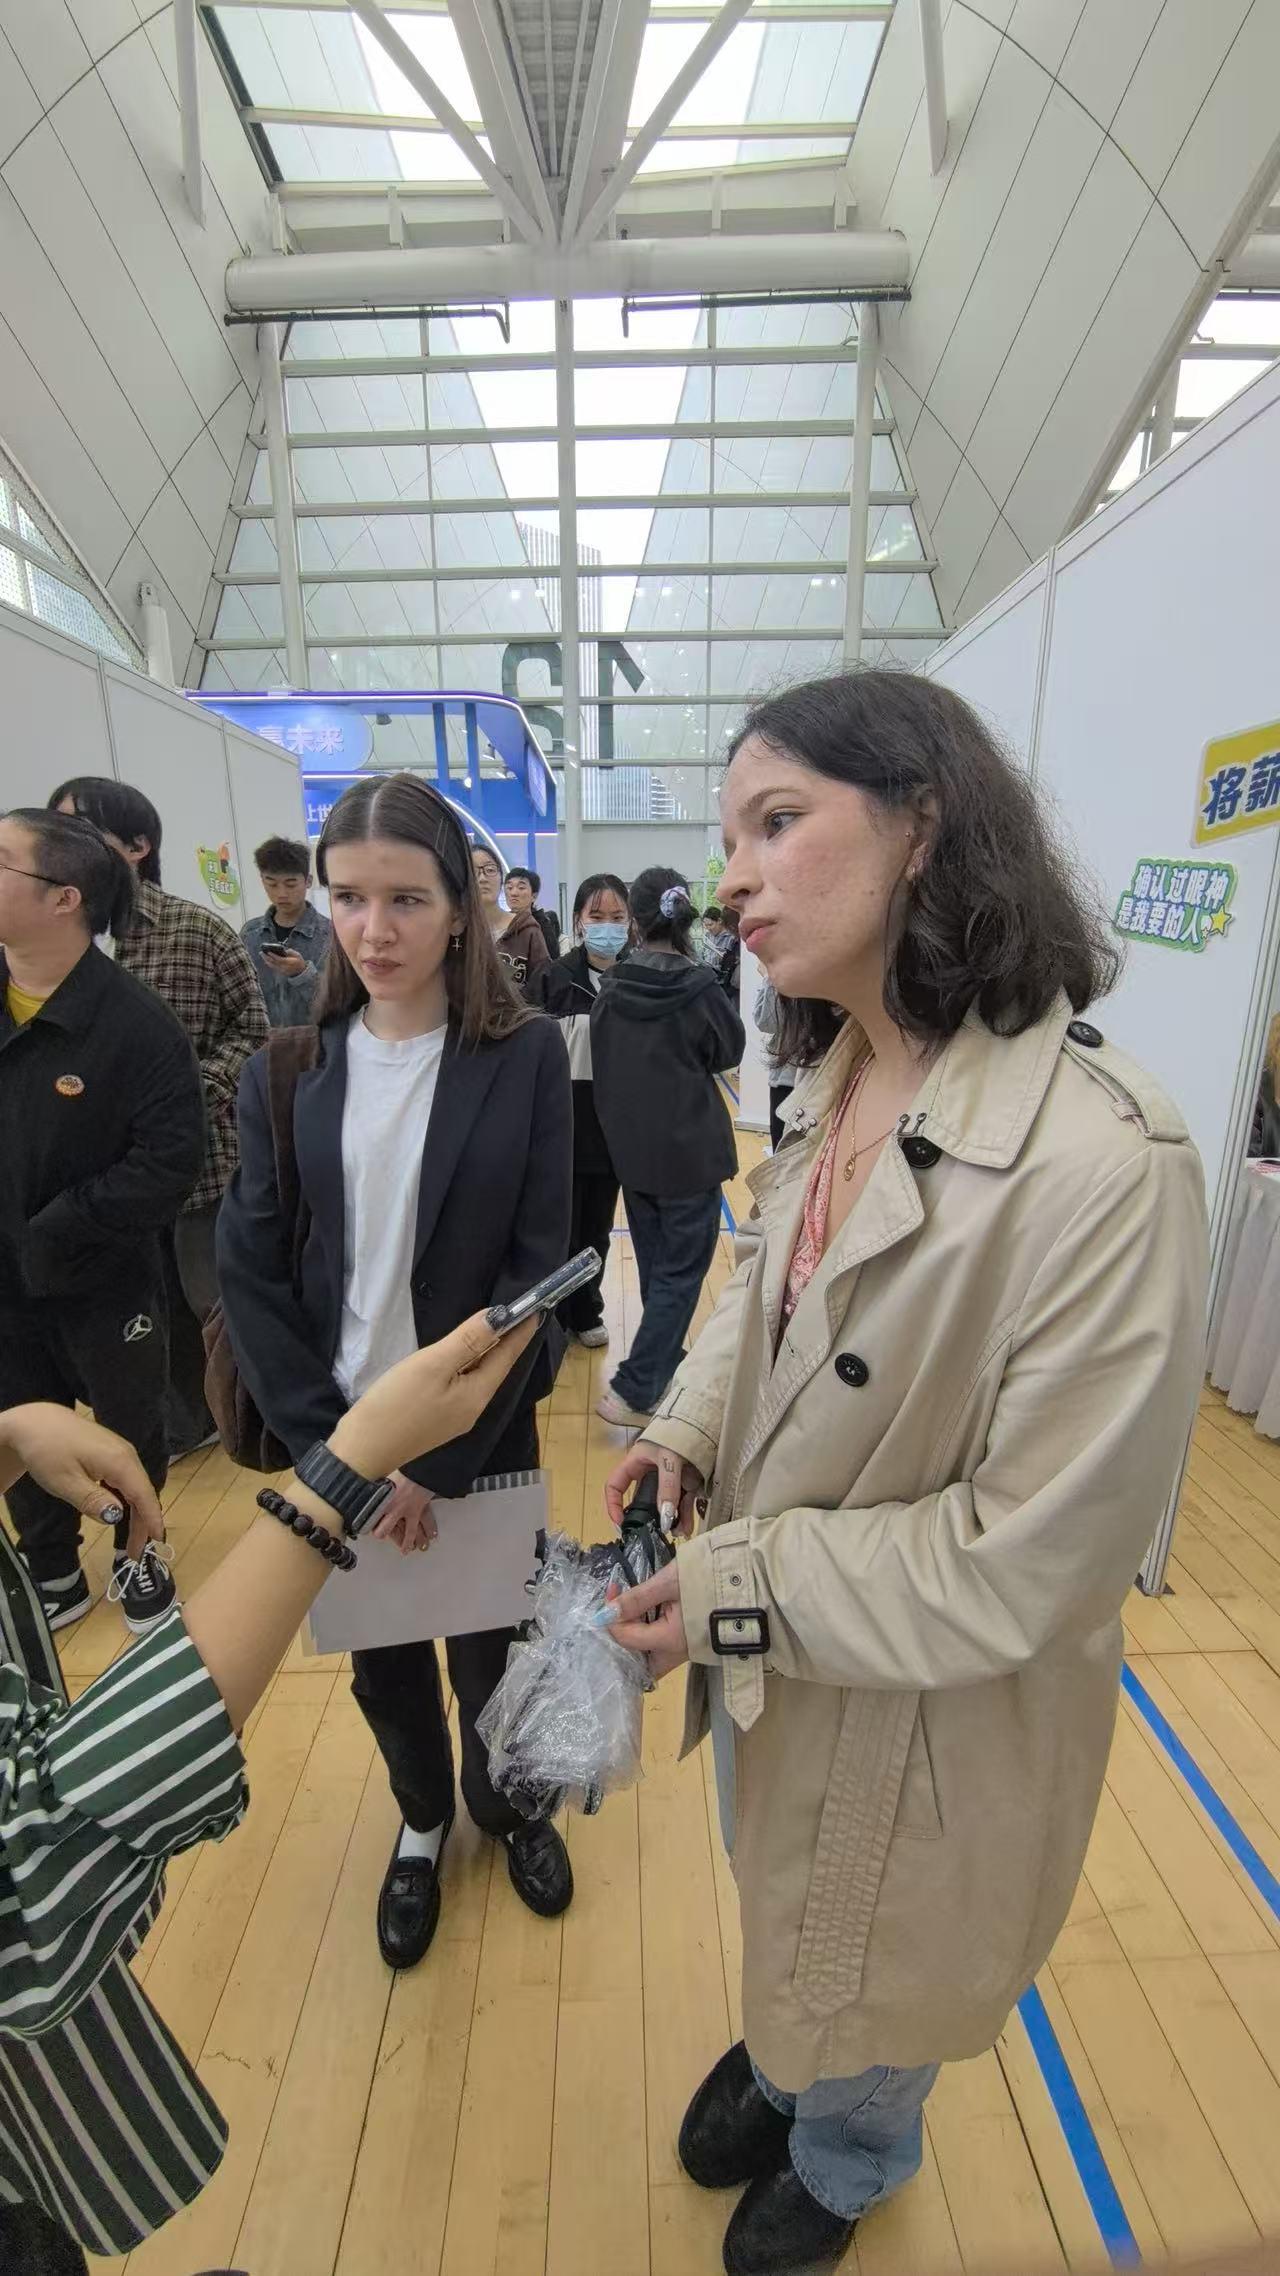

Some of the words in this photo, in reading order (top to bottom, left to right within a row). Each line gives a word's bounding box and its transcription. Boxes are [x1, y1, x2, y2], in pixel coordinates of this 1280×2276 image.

[1203, 752, 1280, 825] 将薪
[1133, 864, 1230, 910] 确认过眼神
[1117, 896, 1201, 945] 是我要的人
